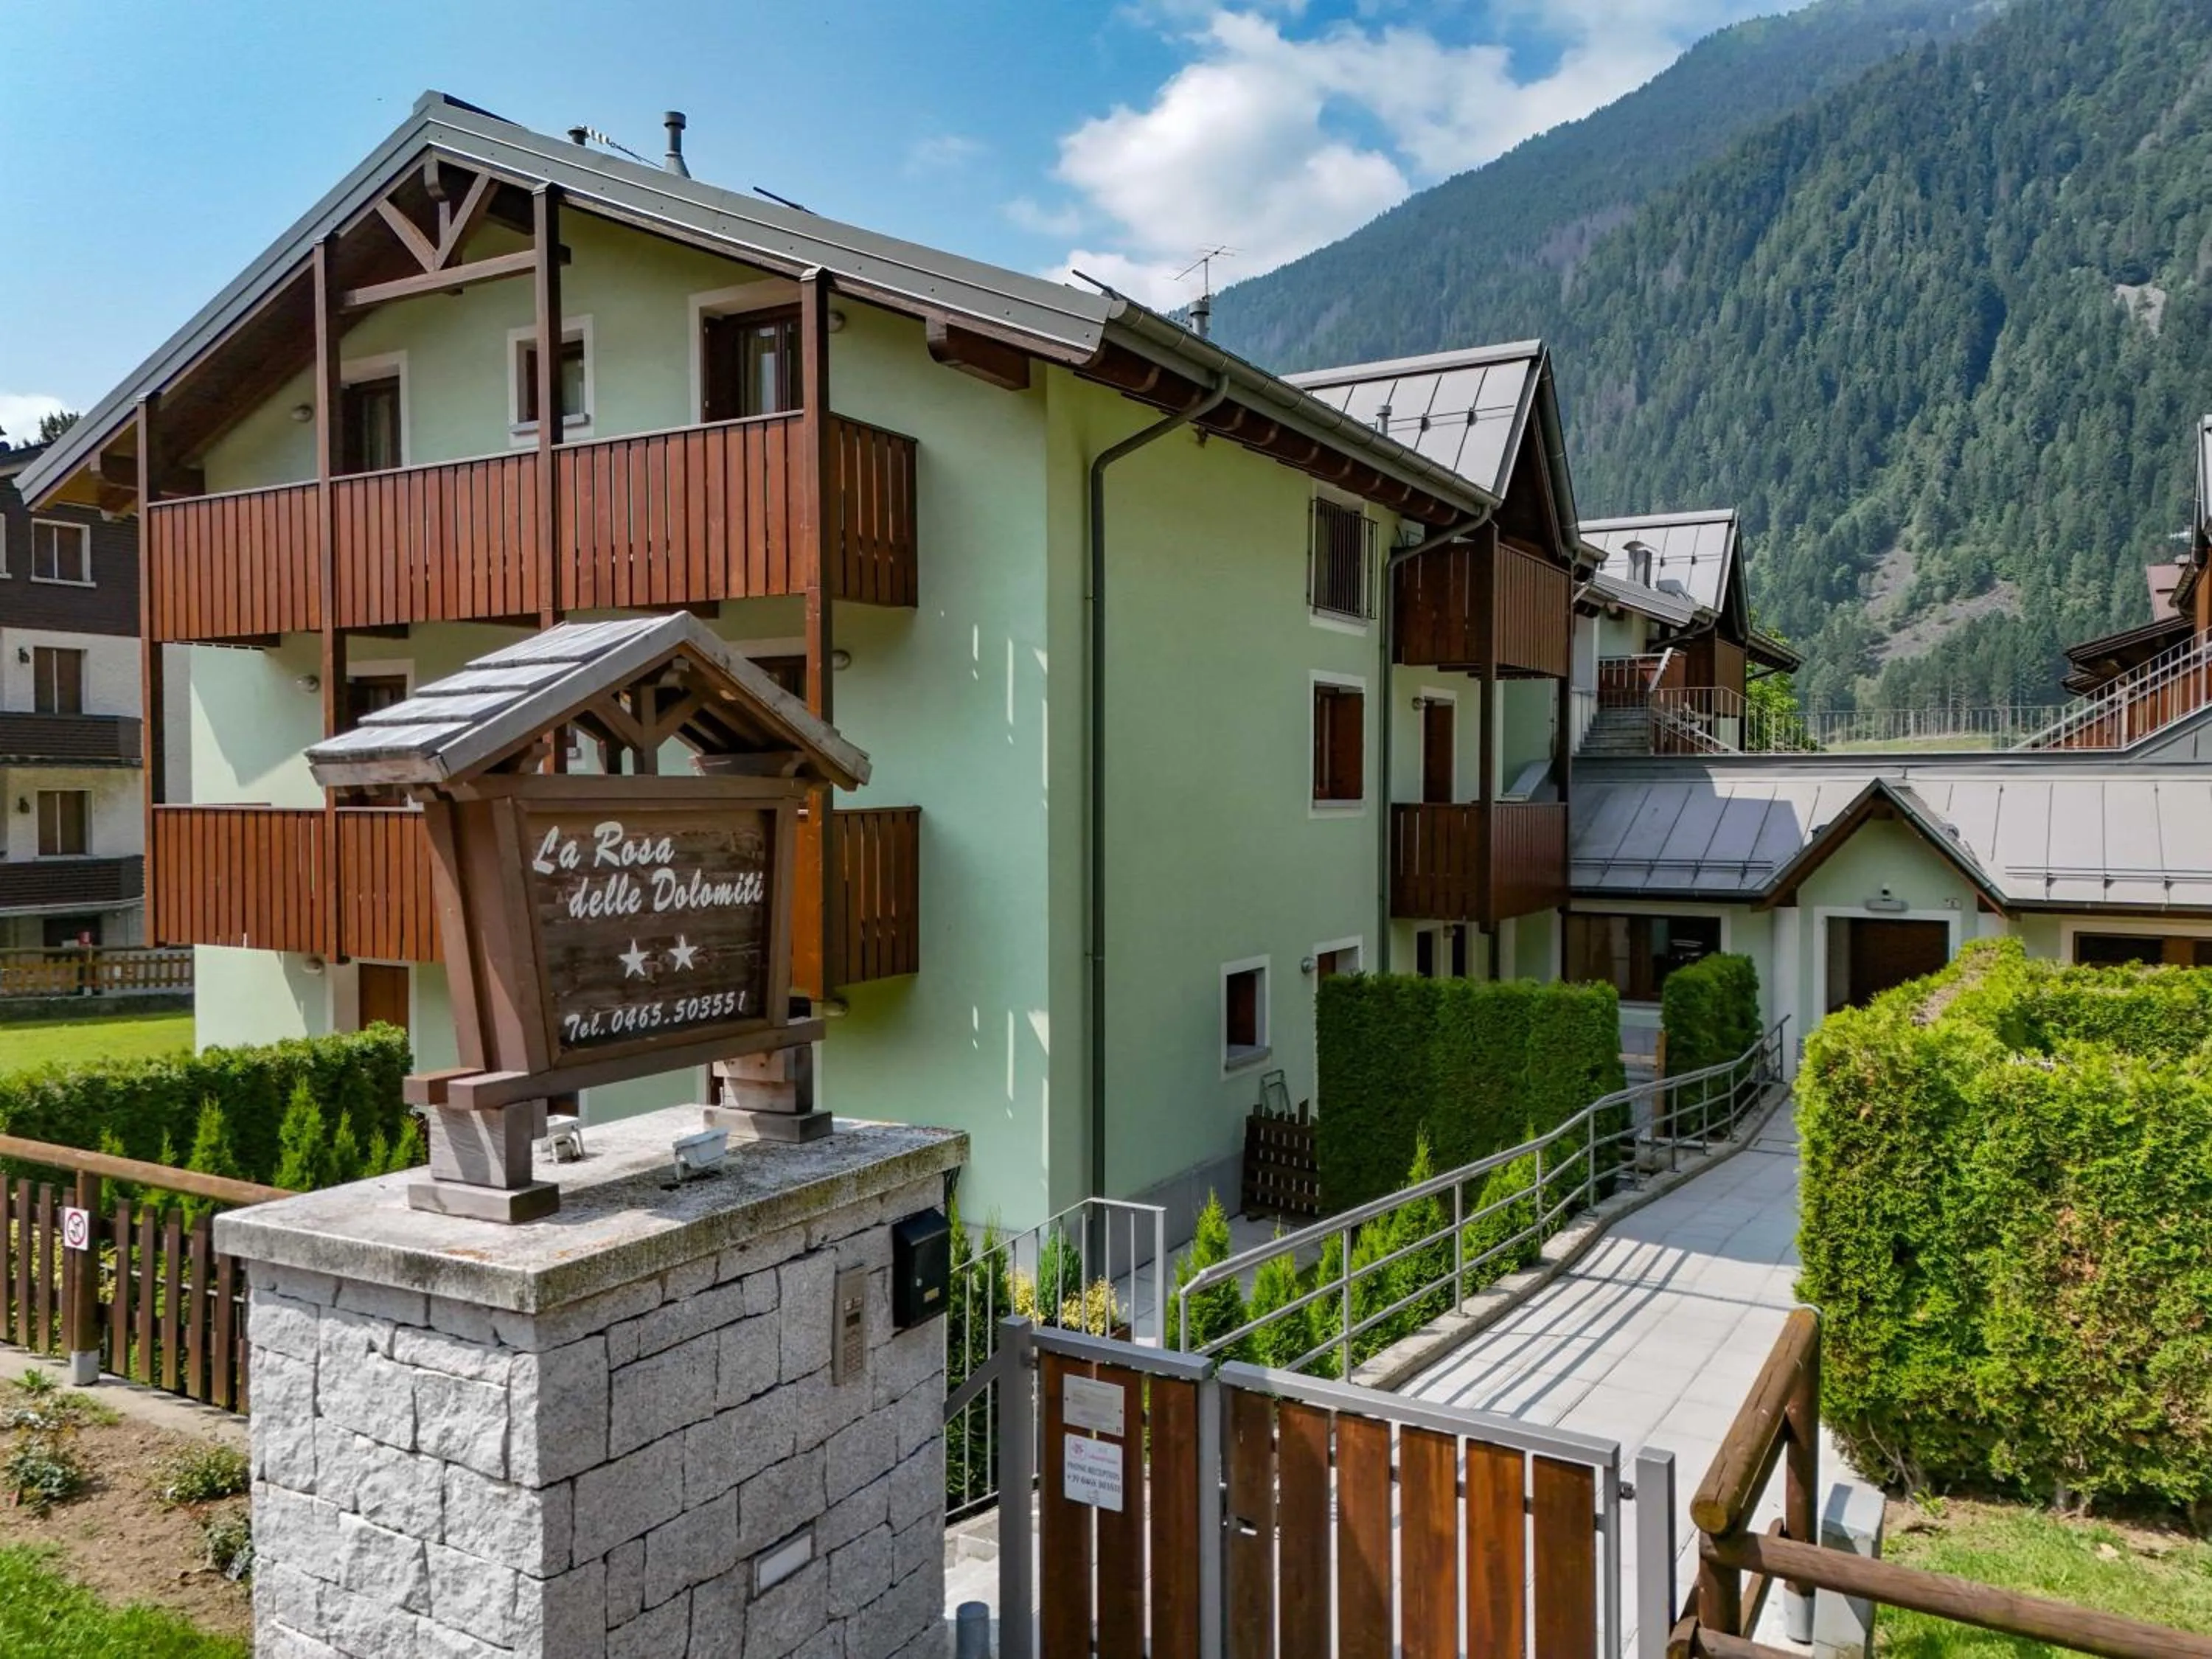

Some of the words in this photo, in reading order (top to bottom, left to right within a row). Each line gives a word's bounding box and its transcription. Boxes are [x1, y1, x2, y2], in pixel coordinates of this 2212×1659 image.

[532, 825, 581, 875] La
[594, 820, 675, 869] Rosa
[568, 874, 643, 919] delle
[651, 867, 765, 914] Dolomiti
[564, 1013, 606, 1042] Tel.
